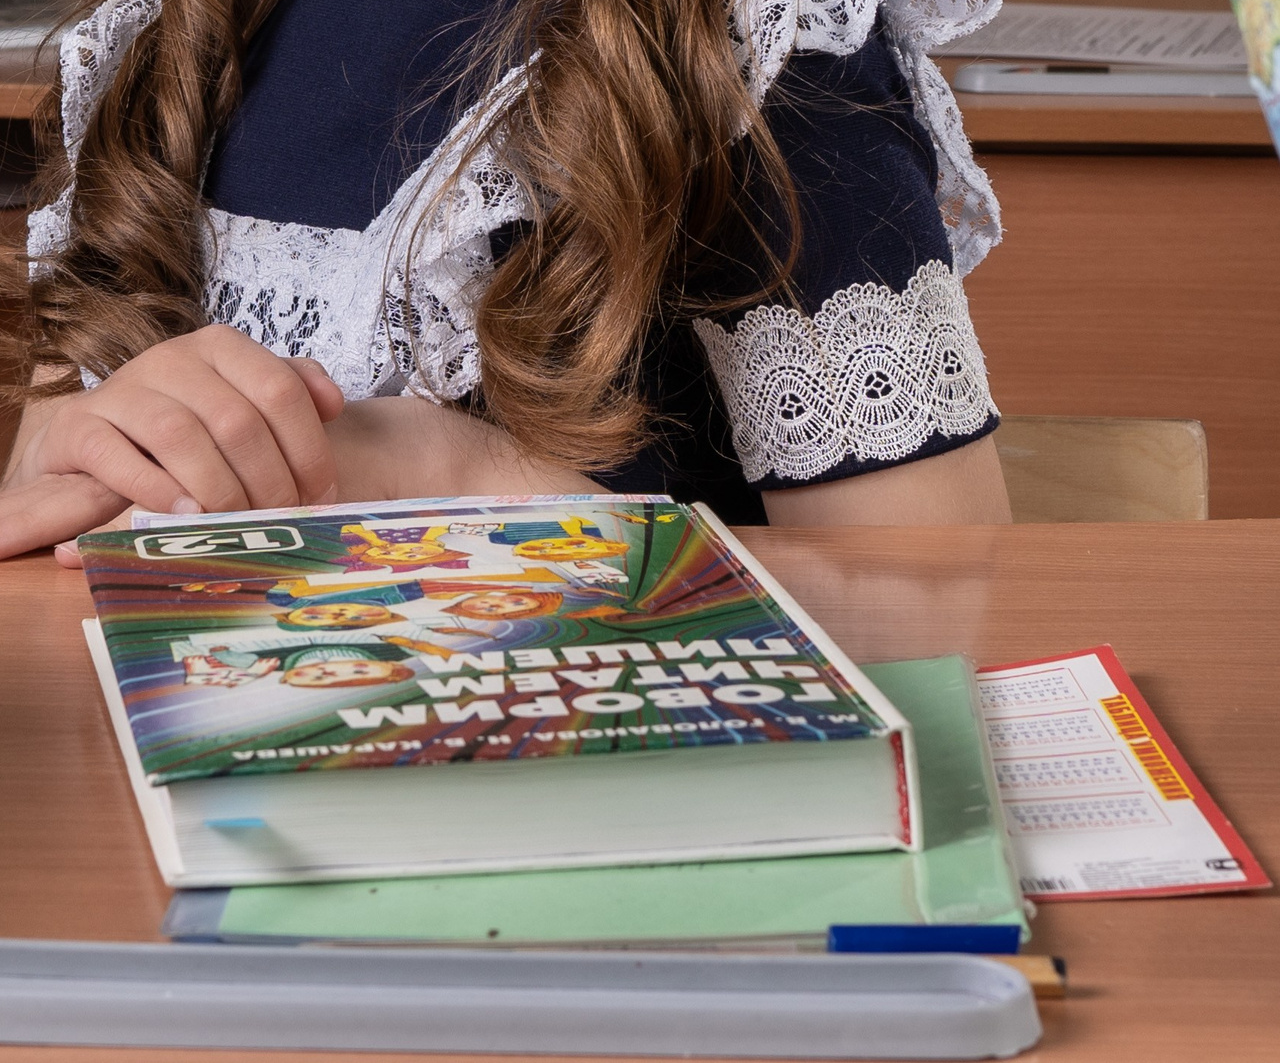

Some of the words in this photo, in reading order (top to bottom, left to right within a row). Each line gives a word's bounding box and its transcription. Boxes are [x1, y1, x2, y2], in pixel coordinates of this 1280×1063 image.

[158, 531, 281, 555] 1-2
[421, 638, 798, 674] ПИШЕМ
[417, 660, 820, 699] ЧИТАЕМ
[336, 683, 838, 730] ГОВОРИМ
[524, 717, 765, 741] ГОЛОВАНОВА,
[231, 739, 422, 761] КАРАШЕВА
